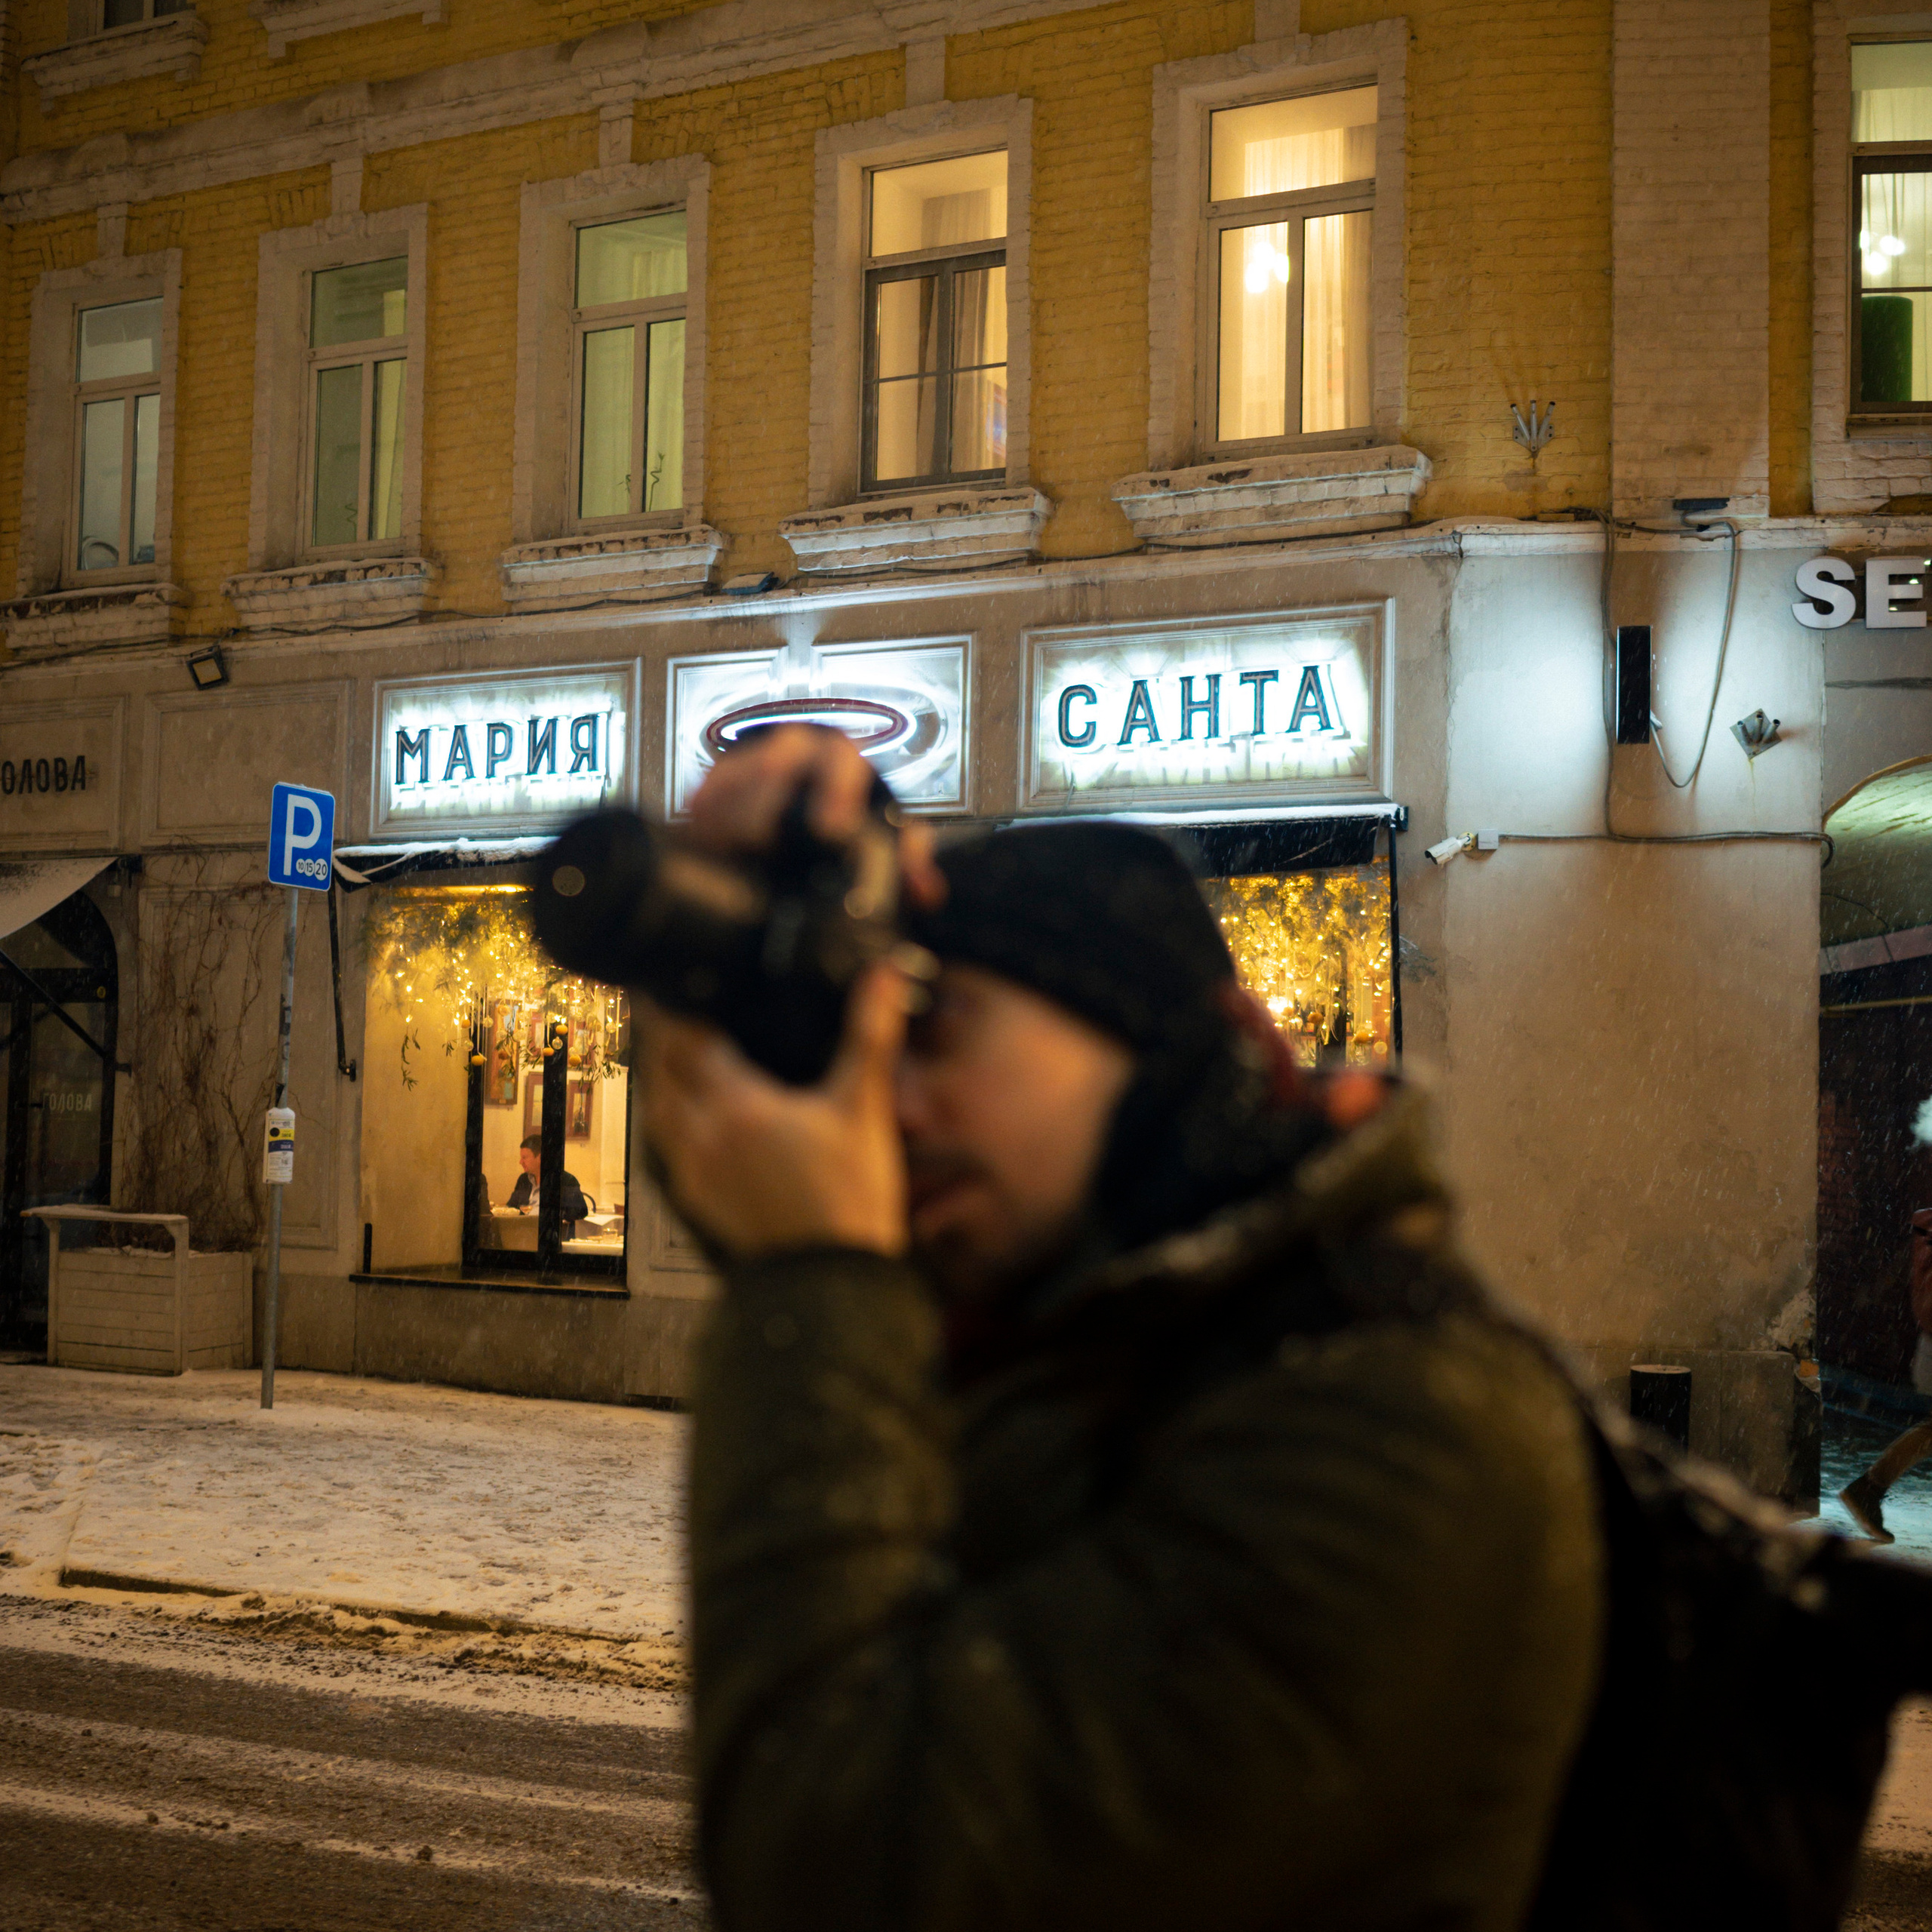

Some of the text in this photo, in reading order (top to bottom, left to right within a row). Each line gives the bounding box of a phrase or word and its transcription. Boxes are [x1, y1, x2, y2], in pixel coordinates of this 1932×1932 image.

[1791, 556, 1927, 629] SE
[1058, 665, 1334, 748] САНТА
[2, 755, 86, 795] ОЛОВА
[395, 714, 598, 785] МАРИЯ
[283, 794, 322, 876] P
[297, 862, 328, 876] 10 15 20
